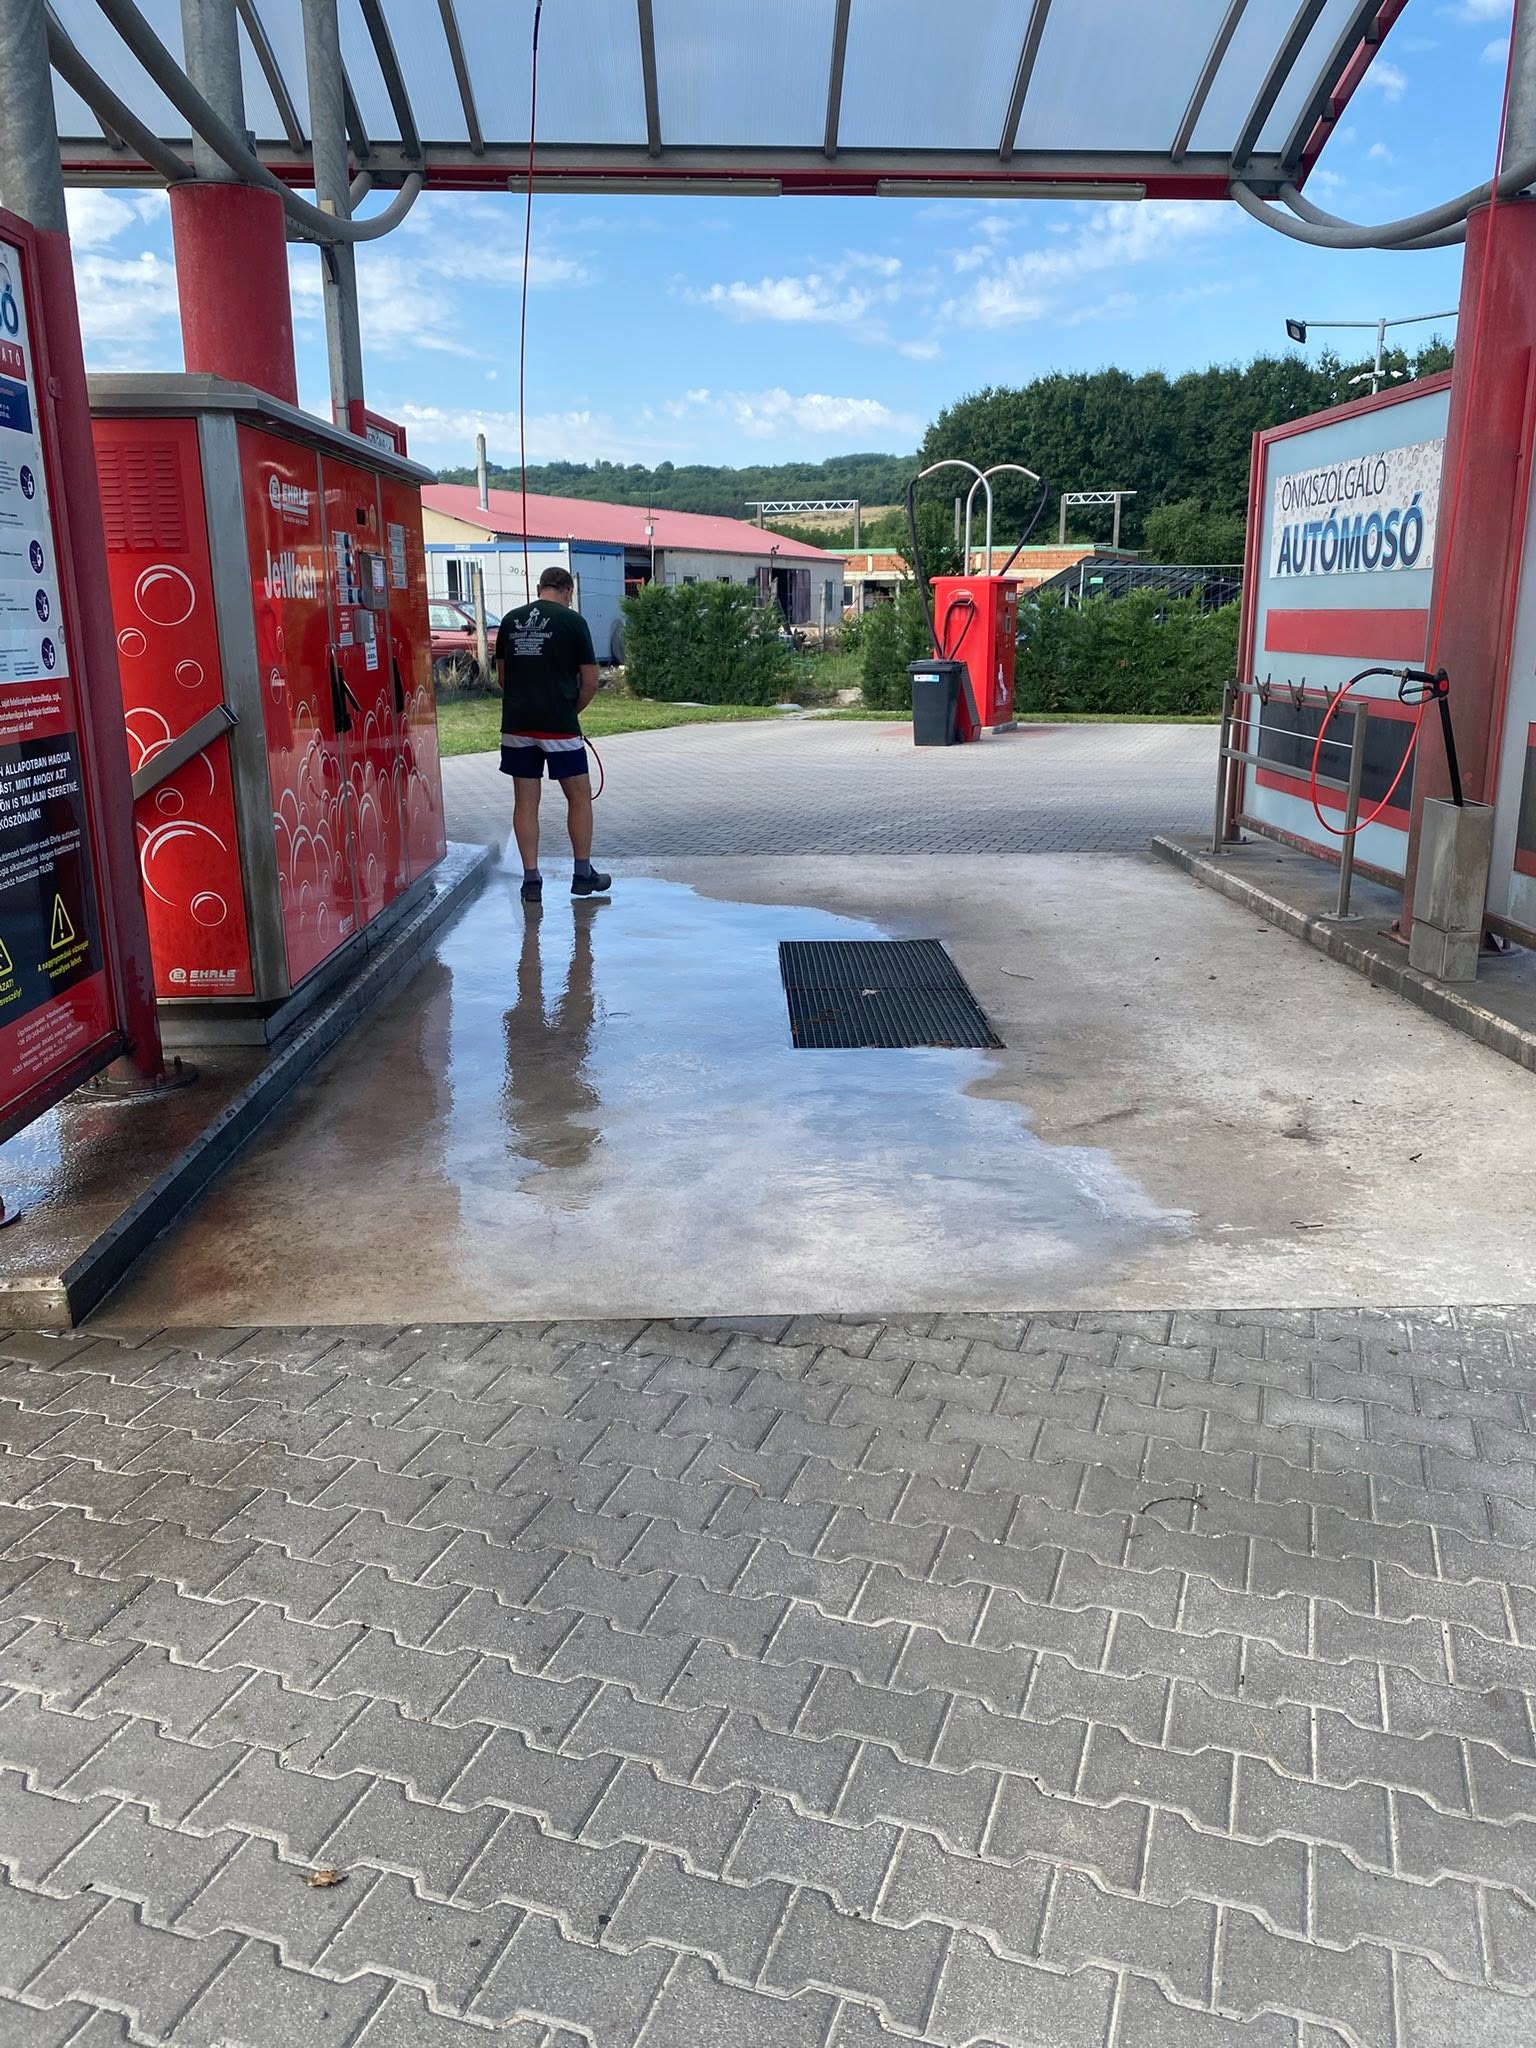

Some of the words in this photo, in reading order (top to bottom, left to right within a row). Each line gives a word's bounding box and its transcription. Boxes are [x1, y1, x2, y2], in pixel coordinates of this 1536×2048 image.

[282, 482, 309, 506] EHRLE
[1281, 452, 1387, 512] ÖNKISZOLGÁLÓ
[1276, 491, 1424, 576] AUTÓMOSÓ
[264, 549, 317, 599] JetWash
[5, 757, 48, 776] ÁLLAPOTBAN
[47, 751, 72, 766] HAGYJA
[15, 777, 32, 791] MINT
[33, 771, 55, 786] AHOGY
[55, 768, 67, 780] AZT
[11, 797, 20, 809] IS
[20, 790, 47, 807] TALÁLNI
[190, 969, 237, 979] EHRLE
